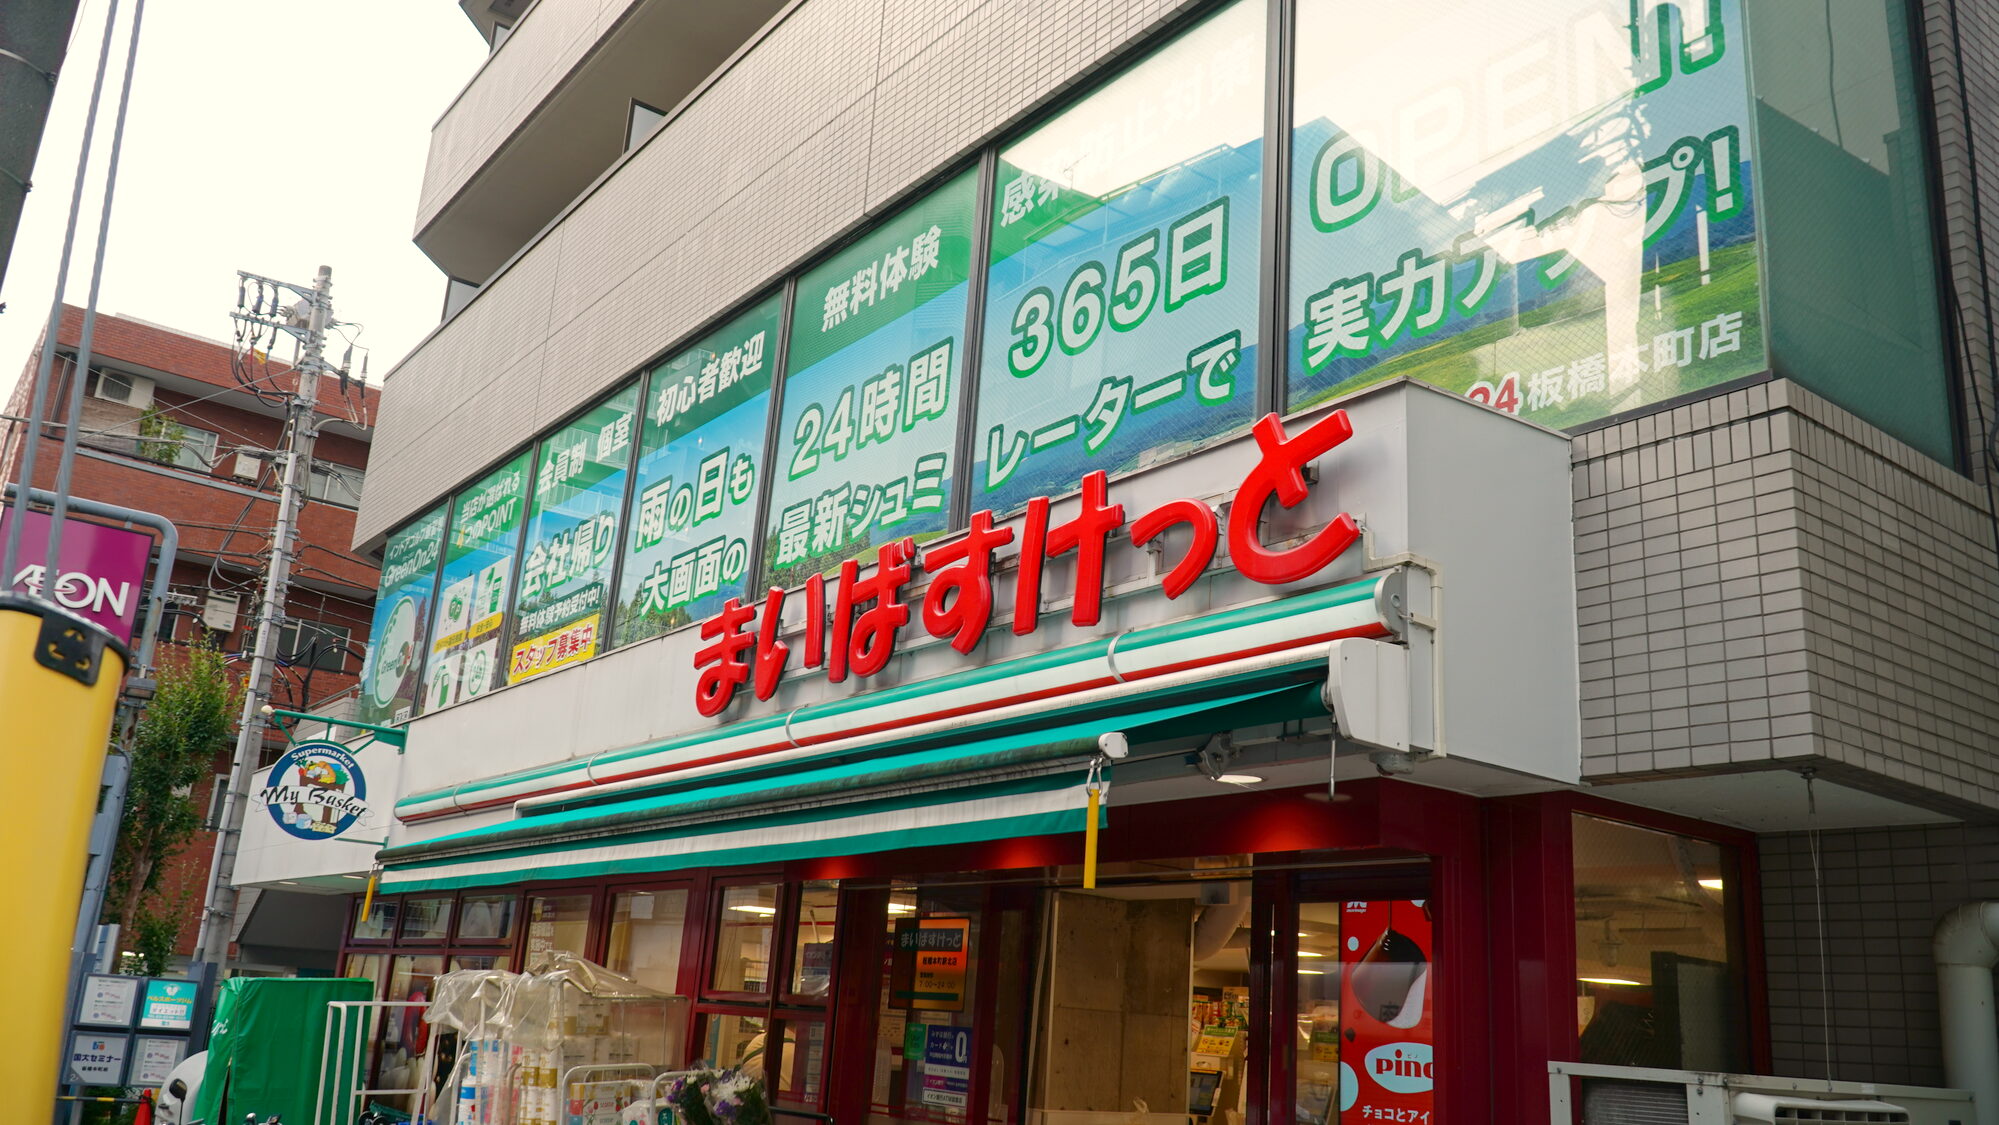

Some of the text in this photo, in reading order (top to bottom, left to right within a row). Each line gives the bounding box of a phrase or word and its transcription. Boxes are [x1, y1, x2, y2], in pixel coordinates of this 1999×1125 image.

[821, 224, 942, 333] 無料体験
[1008, 198, 1230, 378] 365日
[656, 330, 766, 427] 初心者歓迎
[788, 338, 954, 482] 24時間
[985, 331, 1242, 492] レーターで
[537, 413, 633, 496] 会員制 個室
[636, 447, 755, 552] 雨の日も
[521, 511, 617, 601] 会社帰り
[774, 453, 947, 569] 最新シュミ
[640, 535, 747, 619] 大画面の
[694, 408, 1360, 717] まいばすけっと
[513, 623, 594, 675] スタッフ募集中
[519, 585, 600, 635] 無料体験予約受付中!
[260, 785, 366, 816] My Basket
[291, 747, 355, 769] Supermarket
[73, 1053, 121, 1063] 国大セミナー
[1363, 1105, 1430, 1125] チョコとアイ
